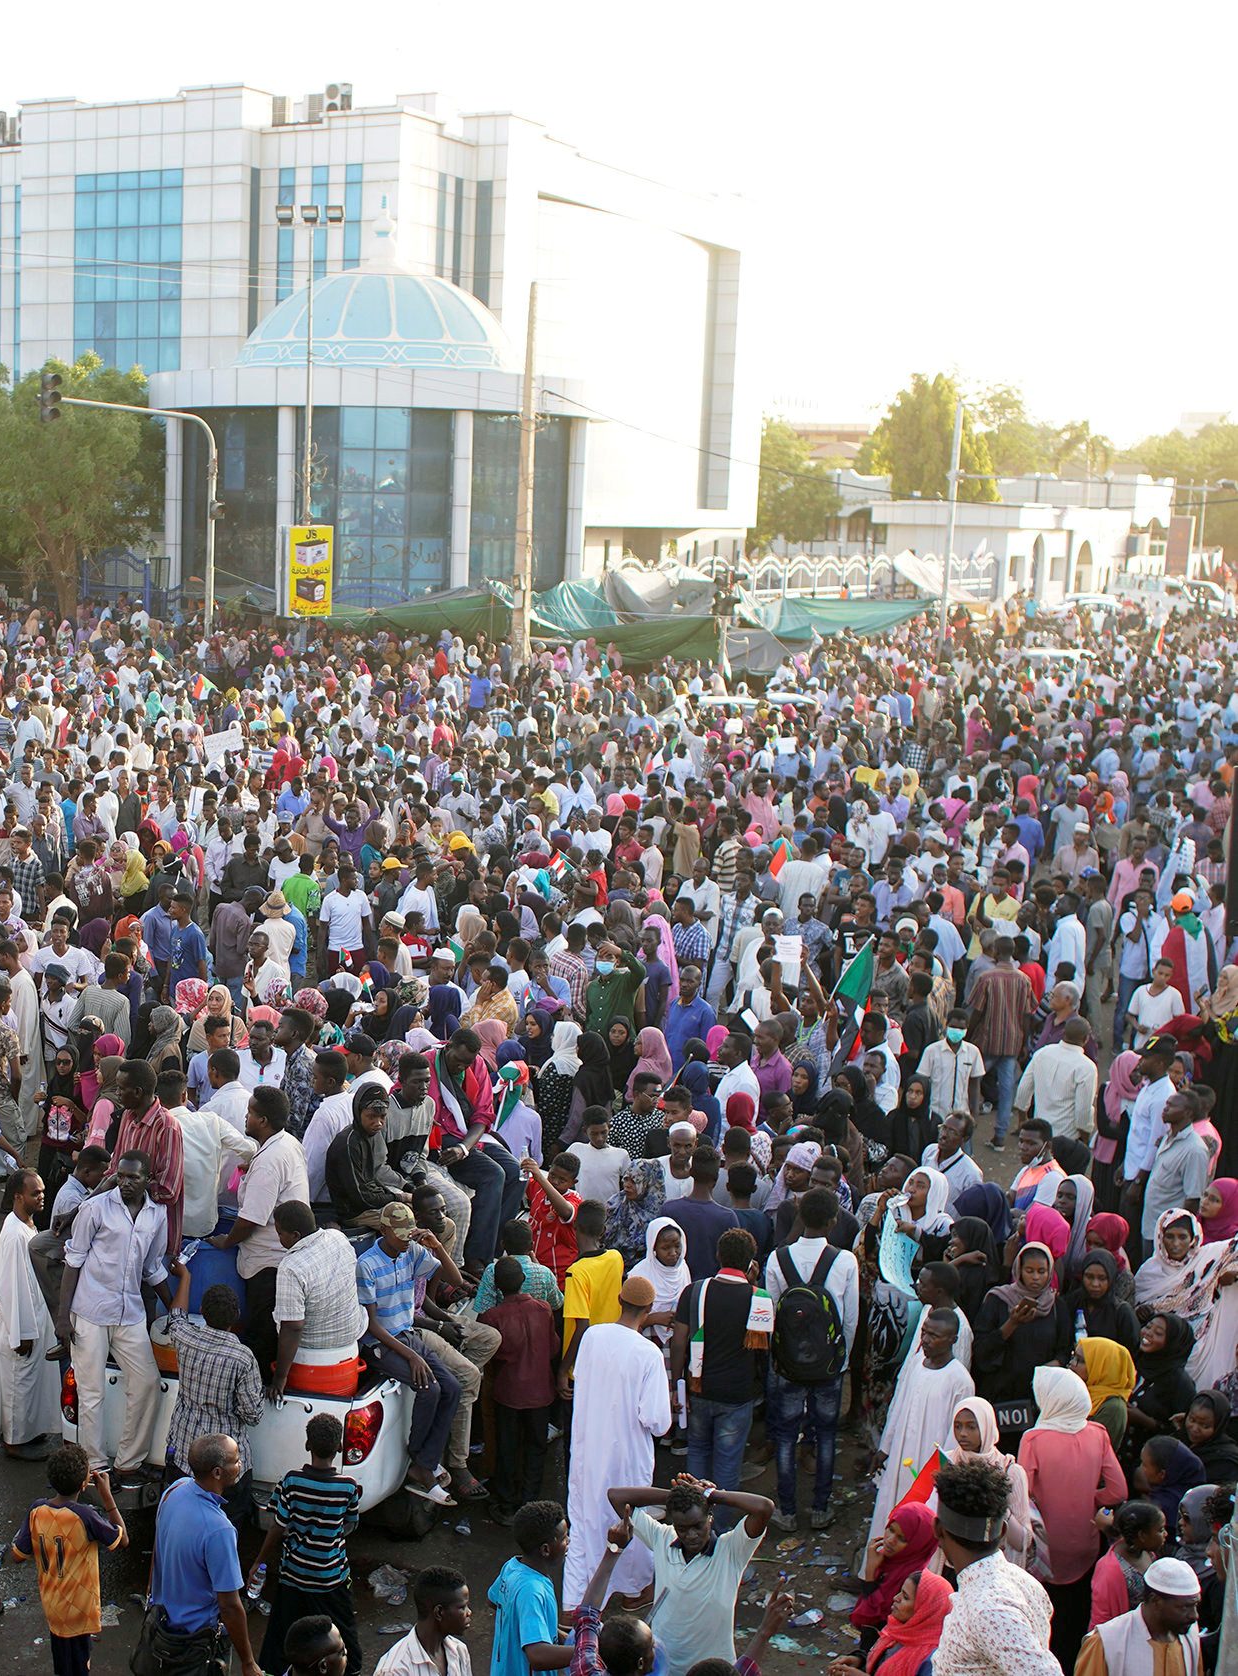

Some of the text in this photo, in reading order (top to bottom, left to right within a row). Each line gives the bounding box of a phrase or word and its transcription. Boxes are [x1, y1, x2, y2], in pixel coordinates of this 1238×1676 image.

[1146, 1036, 1160, 1050] 7
[749, 1314, 771, 1323] canar
[39, 1534, 64, 1578] 11
